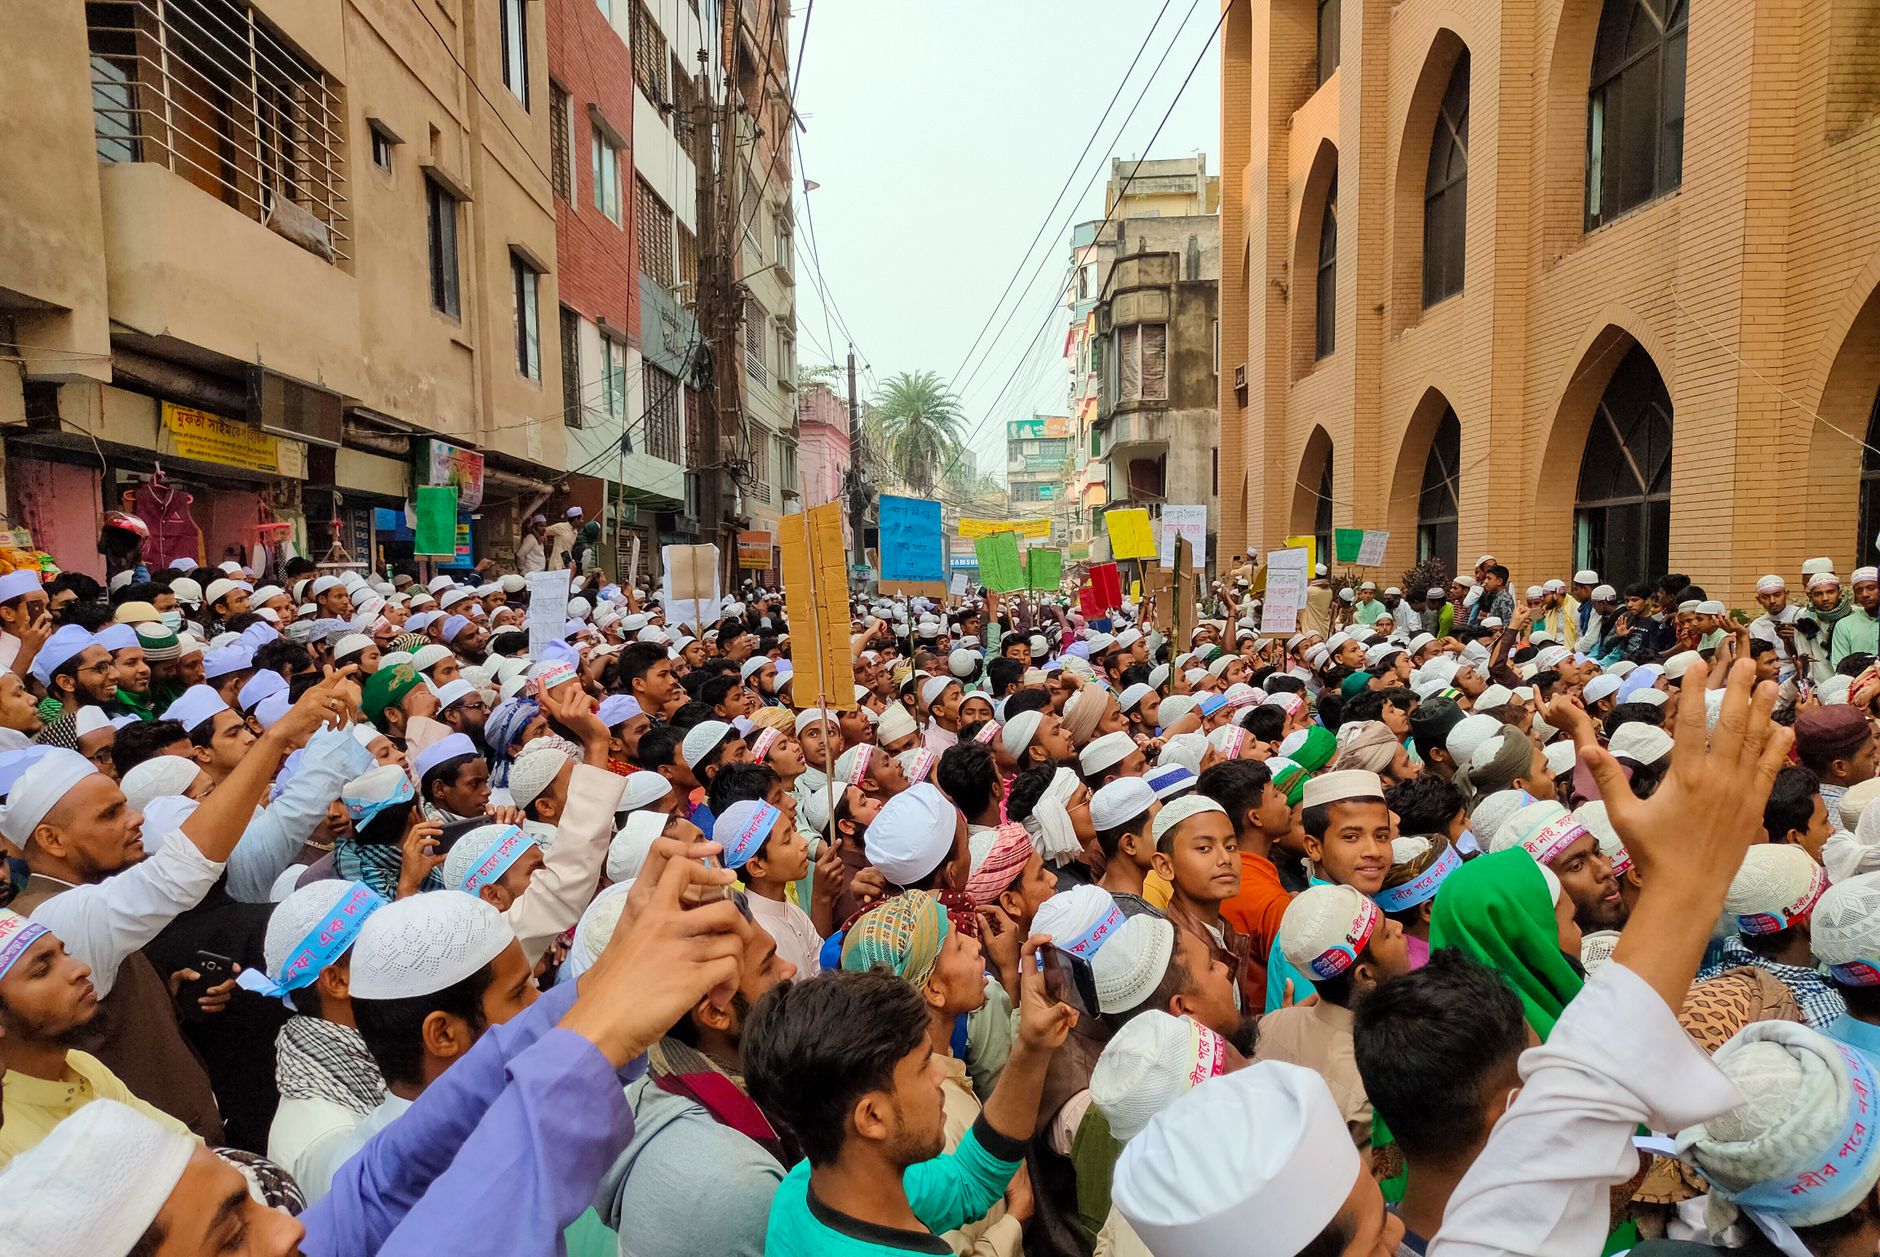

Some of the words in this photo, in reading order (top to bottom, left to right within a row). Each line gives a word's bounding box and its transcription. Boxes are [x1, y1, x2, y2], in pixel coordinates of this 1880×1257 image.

[1523, 841, 1539, 853] বী
[1391, 888, 1413, 901] নবীর
[1414, 876, 1433, 889] পরে
[1432, 862, 1448, 877] নবী
[318, 917, 345, 946] এক
[1092, 923, 1108, 941] এক
[1351, 914, 1365, 934] নবীর
[1198, 1038, 1210, 1059] পরে
[1190, 1062, 1207, 1088] বীর
[1784, 1163, 1839, 1195] নবীর
[1839, 1121, 1866, 1157] পরে
[1853, 1077, 1871, 1115] নবী
